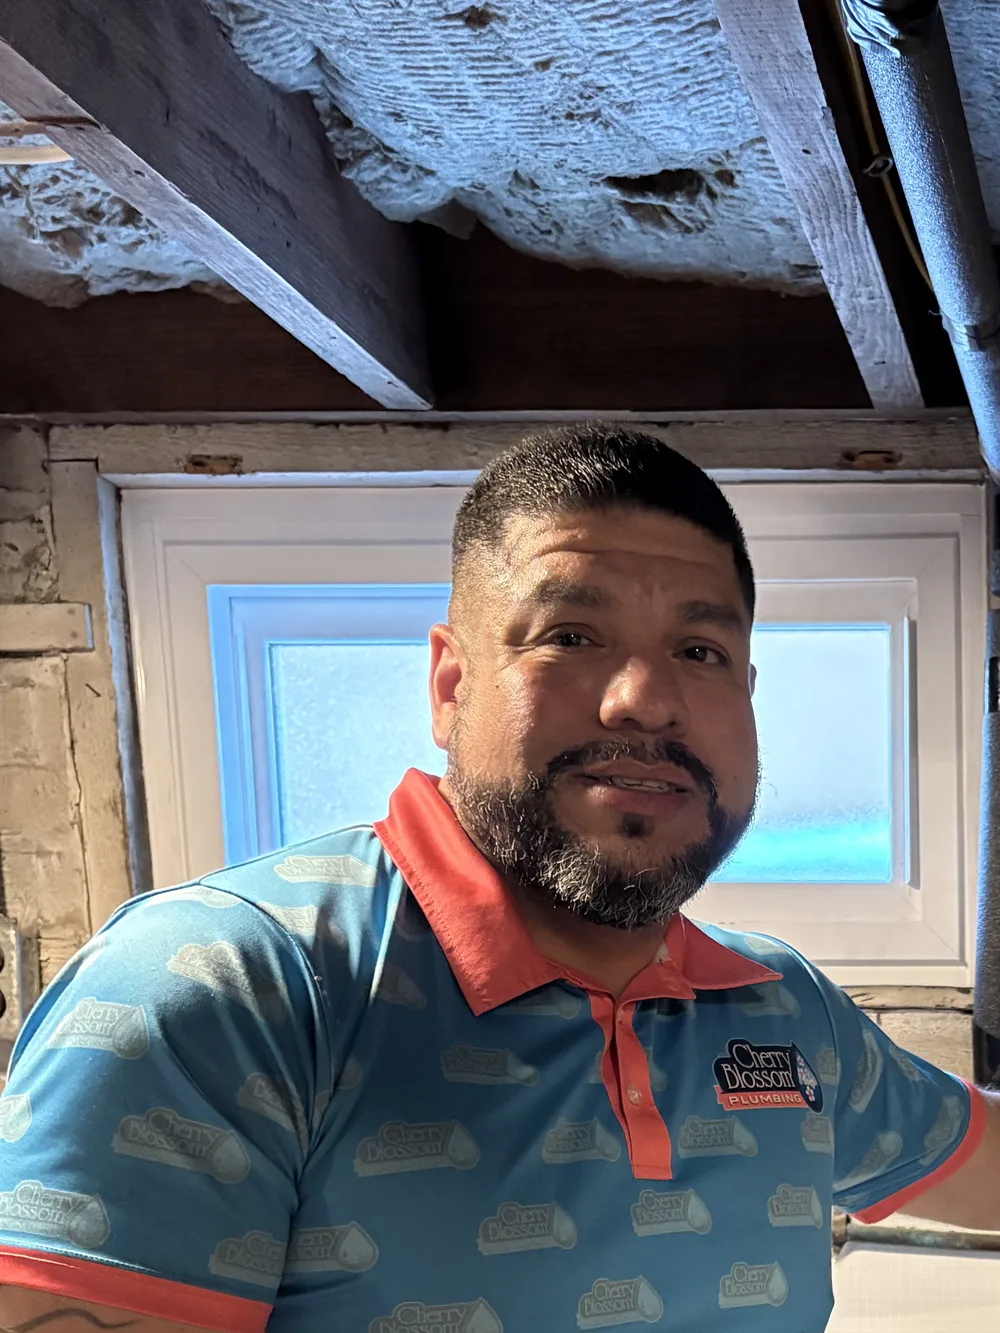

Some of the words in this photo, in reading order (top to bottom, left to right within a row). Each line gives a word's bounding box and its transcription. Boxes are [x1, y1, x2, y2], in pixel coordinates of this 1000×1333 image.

[733, 1044, 791, 1074] Cherry
[721, 1064, 796, 1090] Blossom
[729, 1093, 802, 1106] PLUMBING
[383, 1124, 446, 1148] Cherry
[366, 1141, 444, 1162] Blossom
[501, 1206, 549, 1226] Cherry
[488, 1221, 550, 1240] Blossom
[594, 1282, 636, 1301] Cherry
[397, 1306, 469, 1326] Cherry
[583, 1296, 636, 1316] Blossom
